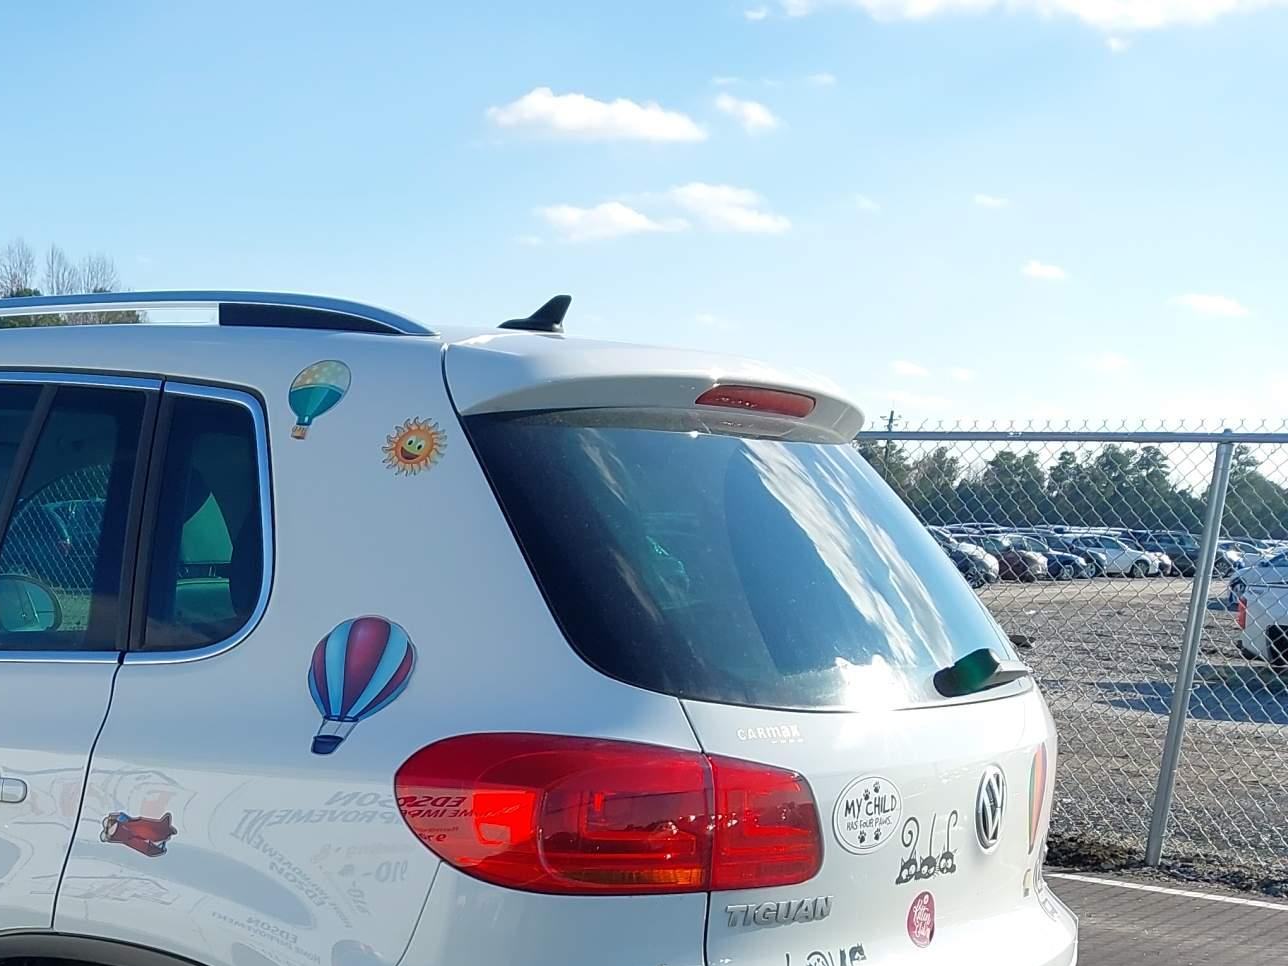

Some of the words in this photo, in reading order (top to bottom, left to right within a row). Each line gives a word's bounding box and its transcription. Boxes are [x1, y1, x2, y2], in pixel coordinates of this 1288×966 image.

[844, 798, 863, 820] MY
[865, 794, 897, 816] CHILD
[726, 896, 834, 927] TIGUAN
